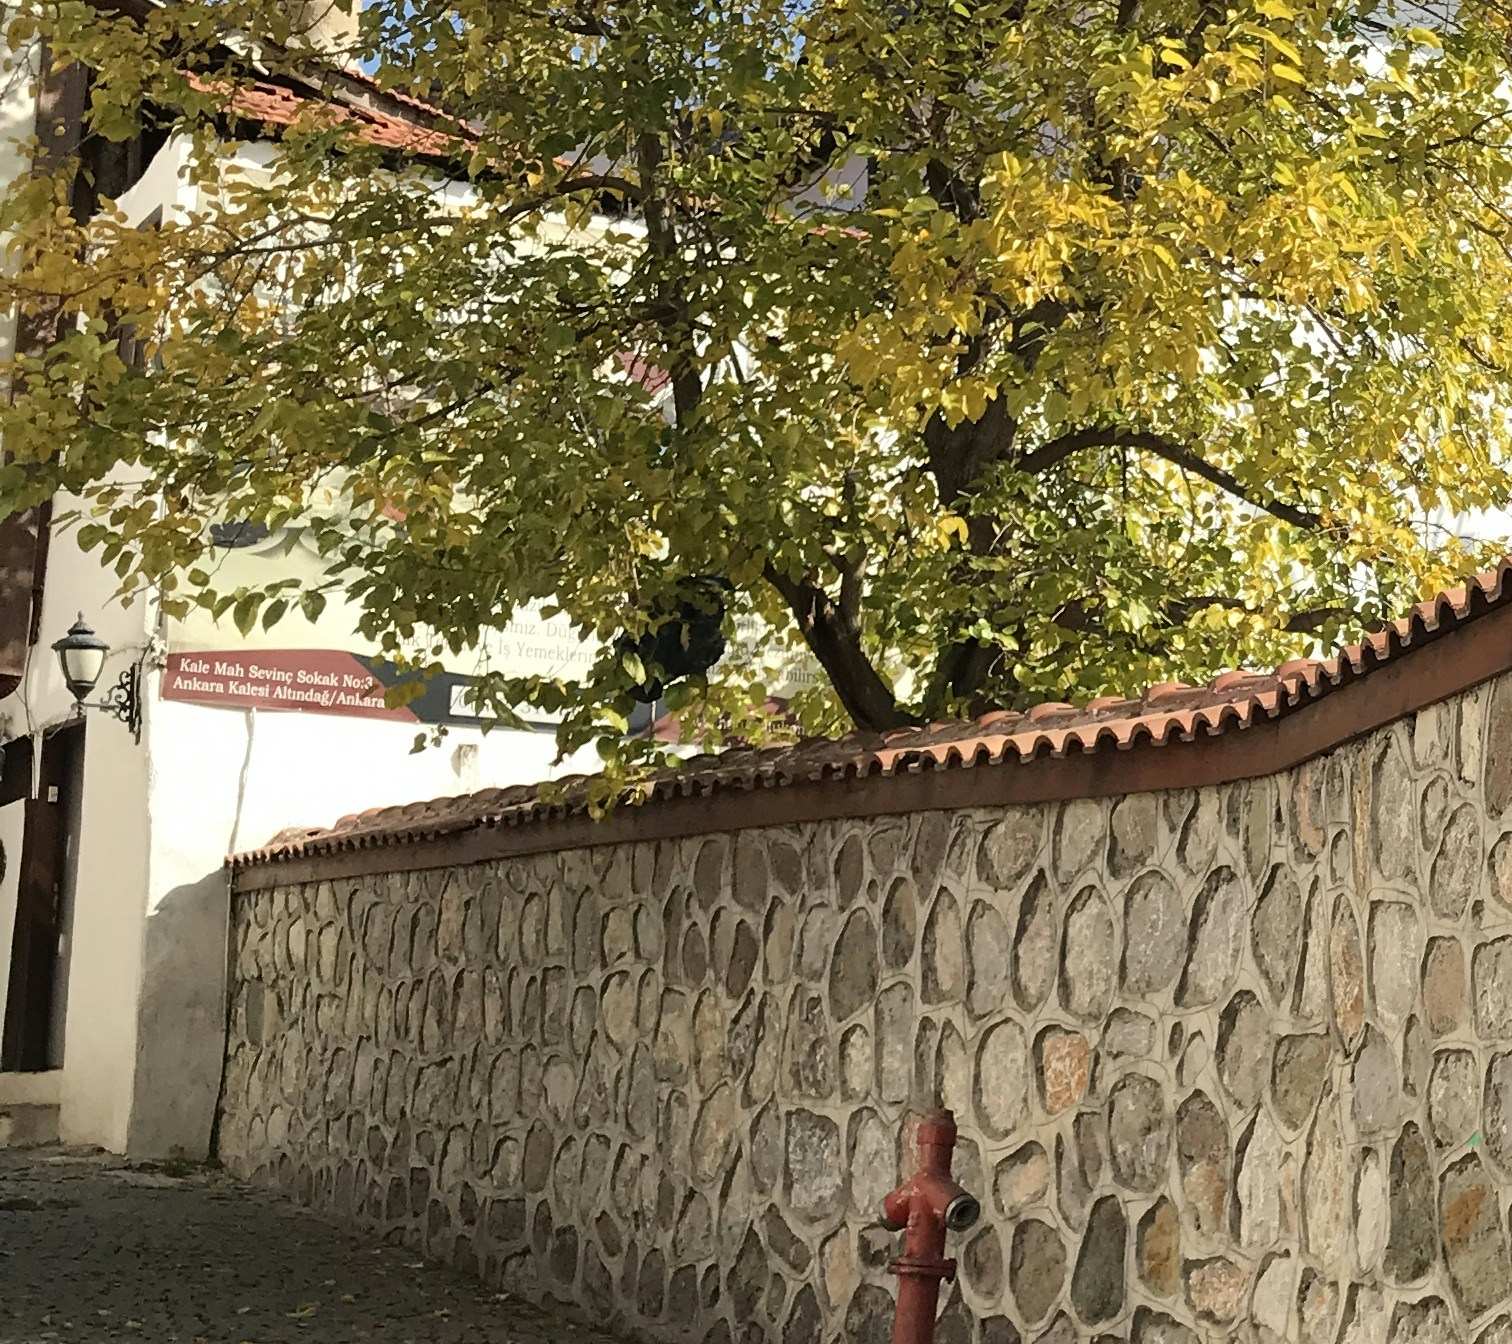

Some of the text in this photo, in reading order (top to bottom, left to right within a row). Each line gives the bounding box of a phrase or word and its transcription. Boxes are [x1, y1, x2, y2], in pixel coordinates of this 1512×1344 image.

[179, 657, 373, 691] Kale Mah Sevinç Sokak No:3
[172, 675, 385, 709] Ankara Kalesi Altındağ/Ankara
